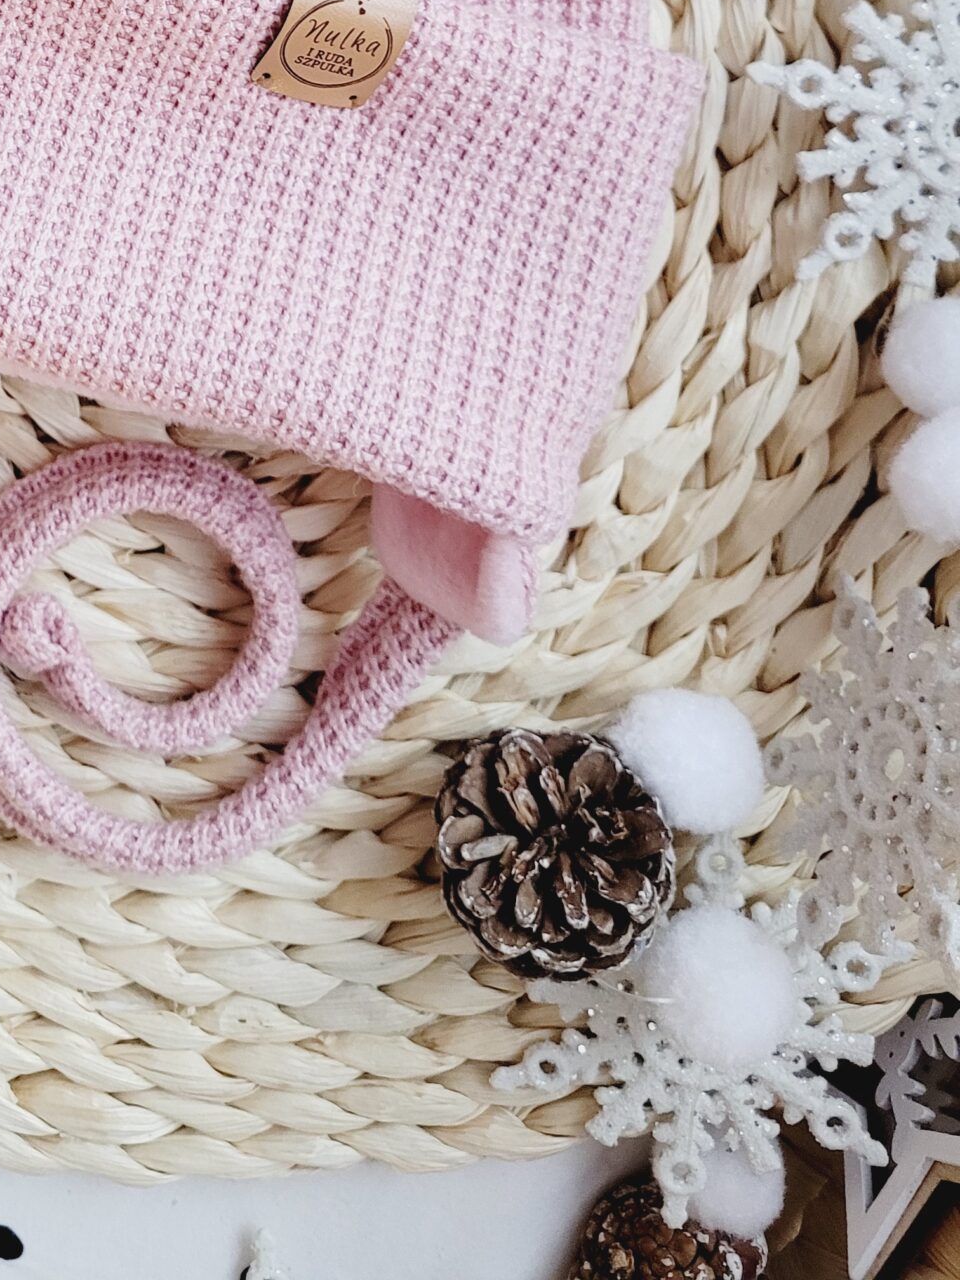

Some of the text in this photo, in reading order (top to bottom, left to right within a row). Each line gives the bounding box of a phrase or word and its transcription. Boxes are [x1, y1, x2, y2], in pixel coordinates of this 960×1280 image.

[304, 18, 381, 57] Nulka
[294, 55, 354, 77] SZPULKA
[306, 47, 353, 67] I RUDA
